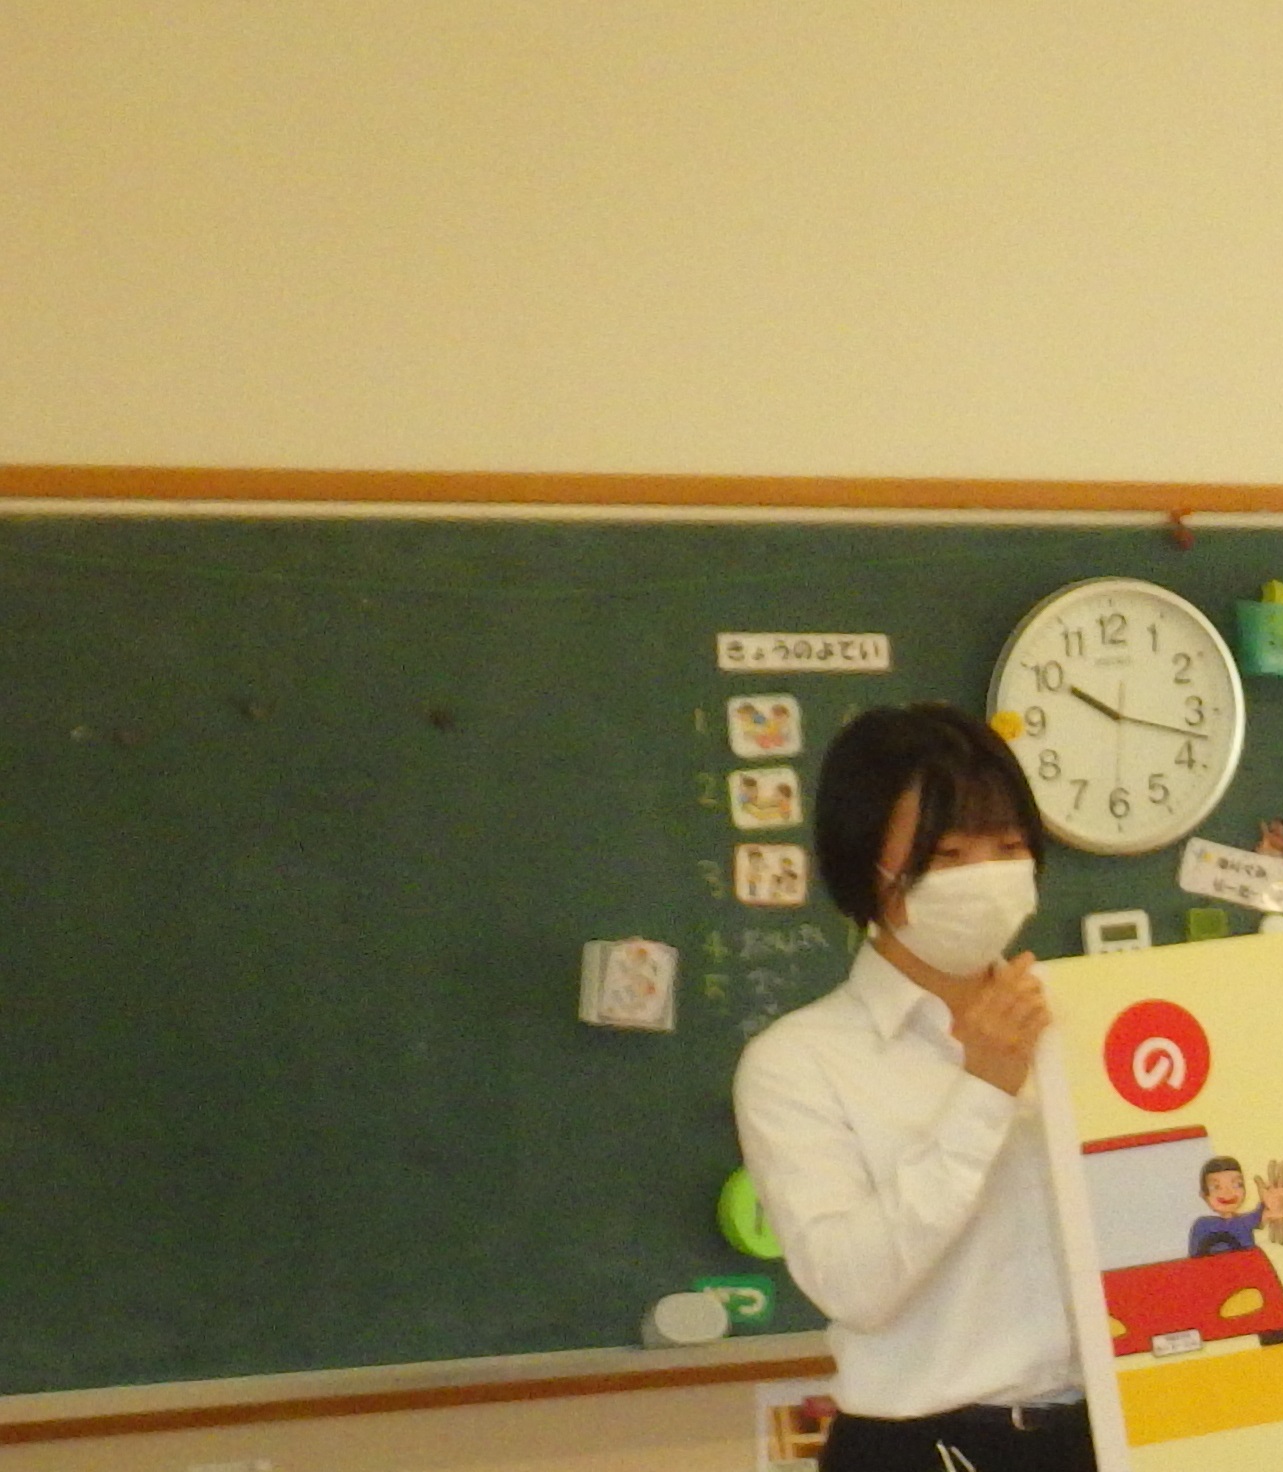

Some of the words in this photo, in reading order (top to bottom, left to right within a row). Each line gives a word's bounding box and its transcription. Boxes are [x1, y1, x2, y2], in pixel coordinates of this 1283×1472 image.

[1062, 627, 1085, 657] 11
[1096, 613, 1128, 646] 12
[1147, 624, 1159, 652] 1
[727, 640, 881, 662] きょうのよてい
[1032, 660, 1065, 693] 10
[1172, 652, 1193, 685] 2
[1025, 705, 1047, 738] 9
[1184, 695, 1206, 727] 3
[1038, 748, 1062, 782] 8
[1174, 739, 1197, 770] 4
[1069, 779, 1090, 811] 7
[1108, 786, 1131, 819] 6
[1147, 773, 1170, 805] 5
[1132, 1036, 1185, 1091] の
